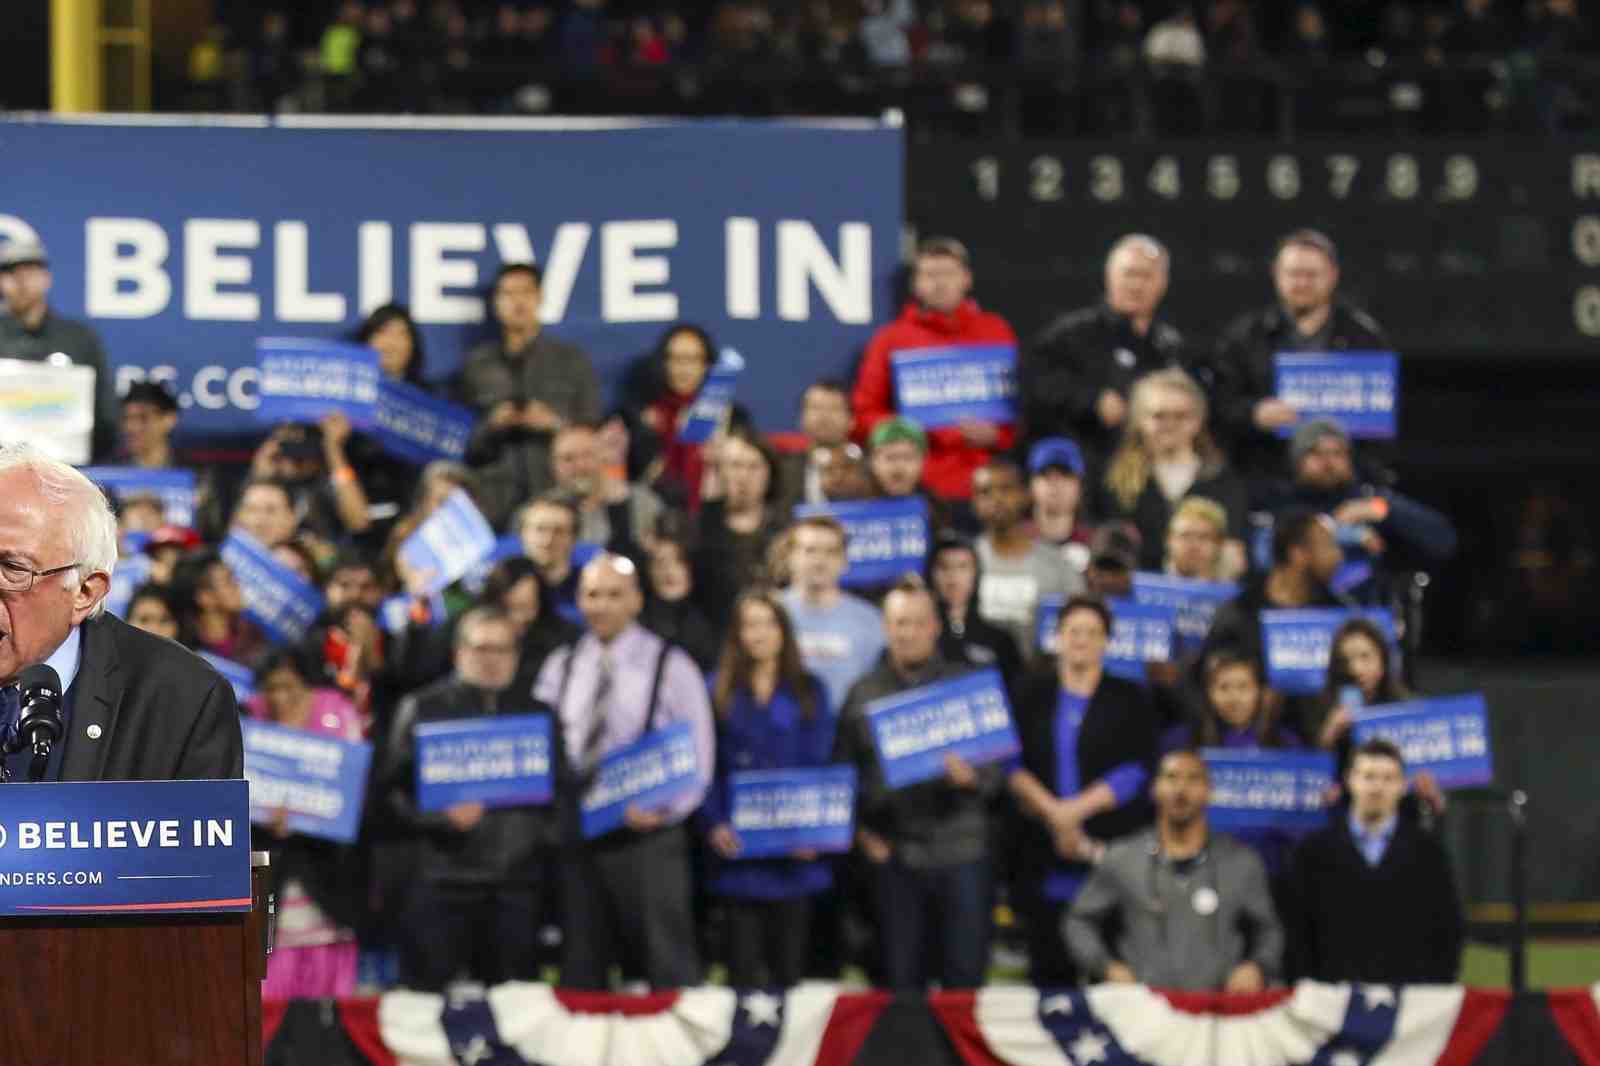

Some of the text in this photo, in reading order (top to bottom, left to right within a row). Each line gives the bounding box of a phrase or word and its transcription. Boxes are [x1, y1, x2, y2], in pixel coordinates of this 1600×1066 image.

[1031, 155, 1062, 200] 2
[1091, 155, 1122, 201] 3
[1150, 155, 1180, 198] 4
[1208, 154, 1238, 199] 5
[1268, 154, 1298, 199] 6
[1330, 154, 1358, 197] 7
[1387, 154, 1418, 199] 8
[1445, 154, 1478, 199] 9
[84, 216, 679, 324] BELIEVE
[726, 216, 873, 325] IN
[18, 821, 180, 849] BELIEVE
[193, 819, 234, 847] IN
